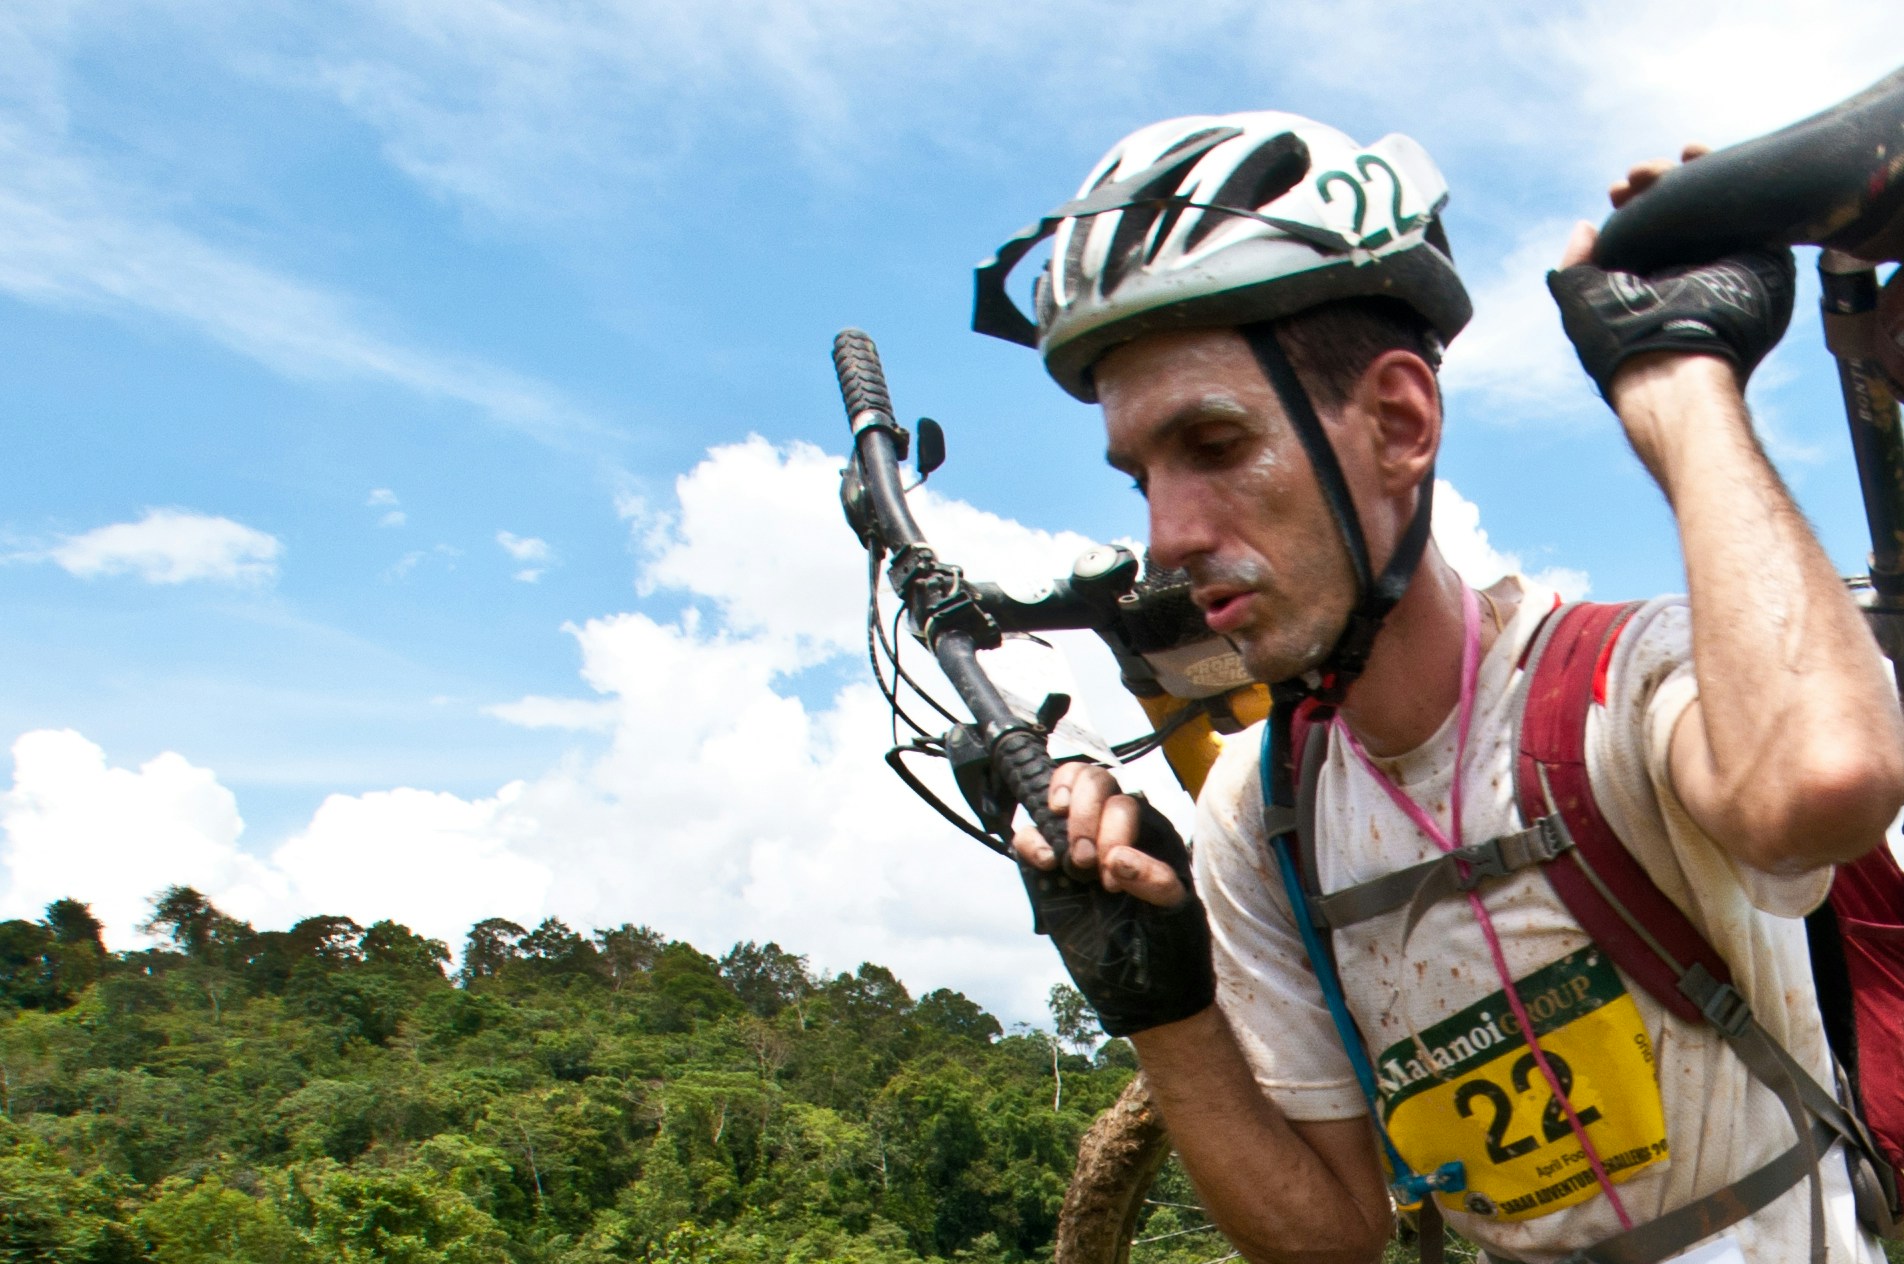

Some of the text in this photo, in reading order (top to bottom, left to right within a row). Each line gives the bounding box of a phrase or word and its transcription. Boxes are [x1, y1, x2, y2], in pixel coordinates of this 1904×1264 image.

[1317, 154, 1431, 249] 22
[1377, 976, 1591, 1099] Maanoi GROUP
[1454, 1048, 1603, 1165] 22
[1535, 1167, 1601, 1206] ADVENTUR
[1562, 1149, 1592, 1167] Foo
